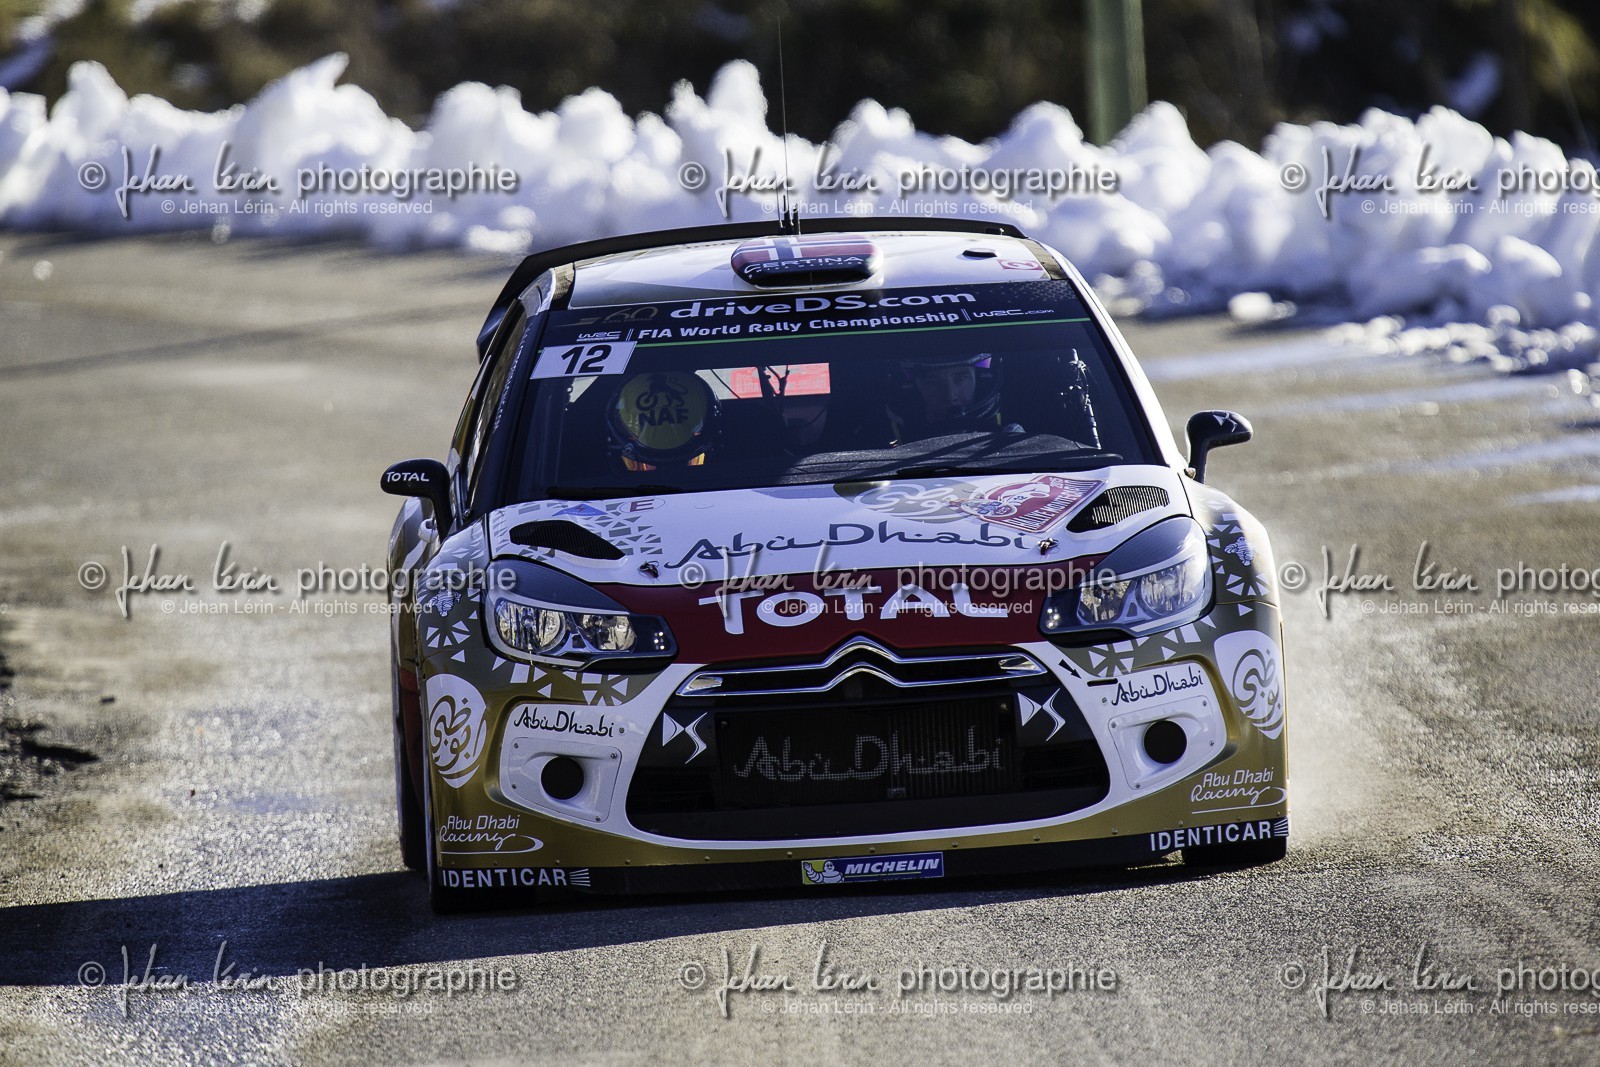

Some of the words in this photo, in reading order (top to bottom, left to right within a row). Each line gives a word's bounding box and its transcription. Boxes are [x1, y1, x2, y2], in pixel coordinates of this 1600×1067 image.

[744, 257, 864, 274] CERTINA
[670, 293, 976, 319] driveDS.com
[638, 328, 673, 340] FIA
[680, 324, 741, 338] World
[749, 321, 802, 333] Rally
[809, 312, 960, 329] Championship
[561, 344, 612, 375] 12
[638, 407, 689, 427] NAF
[386, 471, 430, 483] TOTAL
[698, 583, 1009, 635] TOTAL
[1203, 773, 1231, 789] Abu
[1233, 767, 1275, 786] Dhabi
[1189, 784, 1271, 805] Racing
[446, 815, 473, 831] Abu
[475, 814, 521, 830] Dhabi
[439, 825, 517, 851] Racing
[1150, 820, 1272, 852] IDENTICAR
[844, 858, 940, 875] MICHELIN
[441, 868, 568, 888] IDENTICAR
